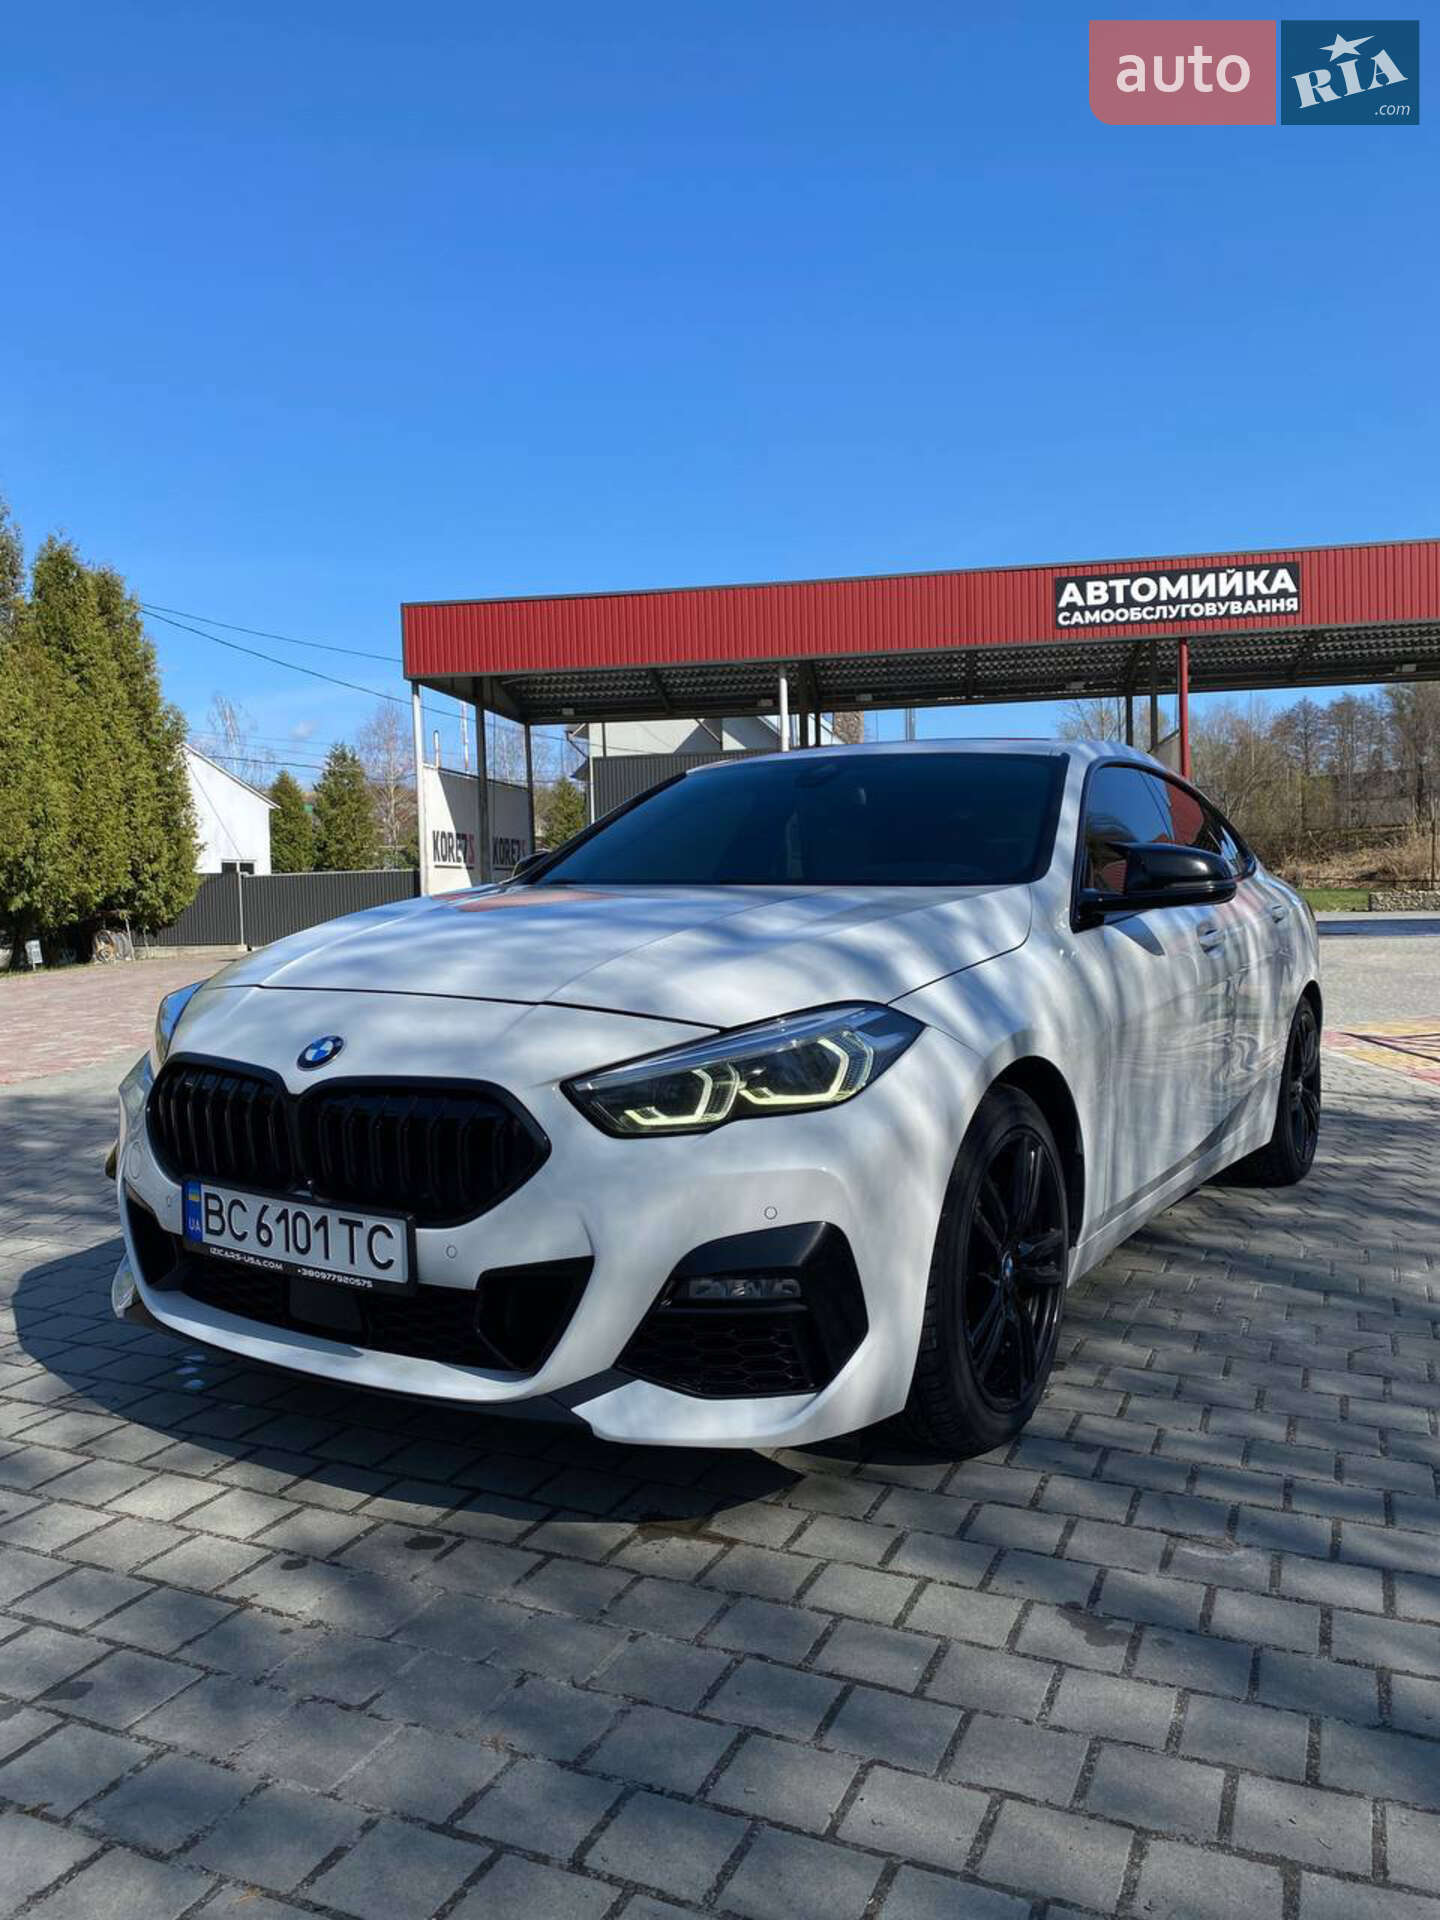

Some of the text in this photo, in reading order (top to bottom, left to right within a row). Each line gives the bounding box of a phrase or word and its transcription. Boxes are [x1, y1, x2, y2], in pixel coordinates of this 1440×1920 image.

[1058, 568, 1297, 608] АВТОМИЙКА
[1057, 597, 1299, 626] САМООБСЛУГОВУВАННЯ
[188, 1216, 201, 1233] UA
[204, 1192, 395, 1270] BC 6101 TC
